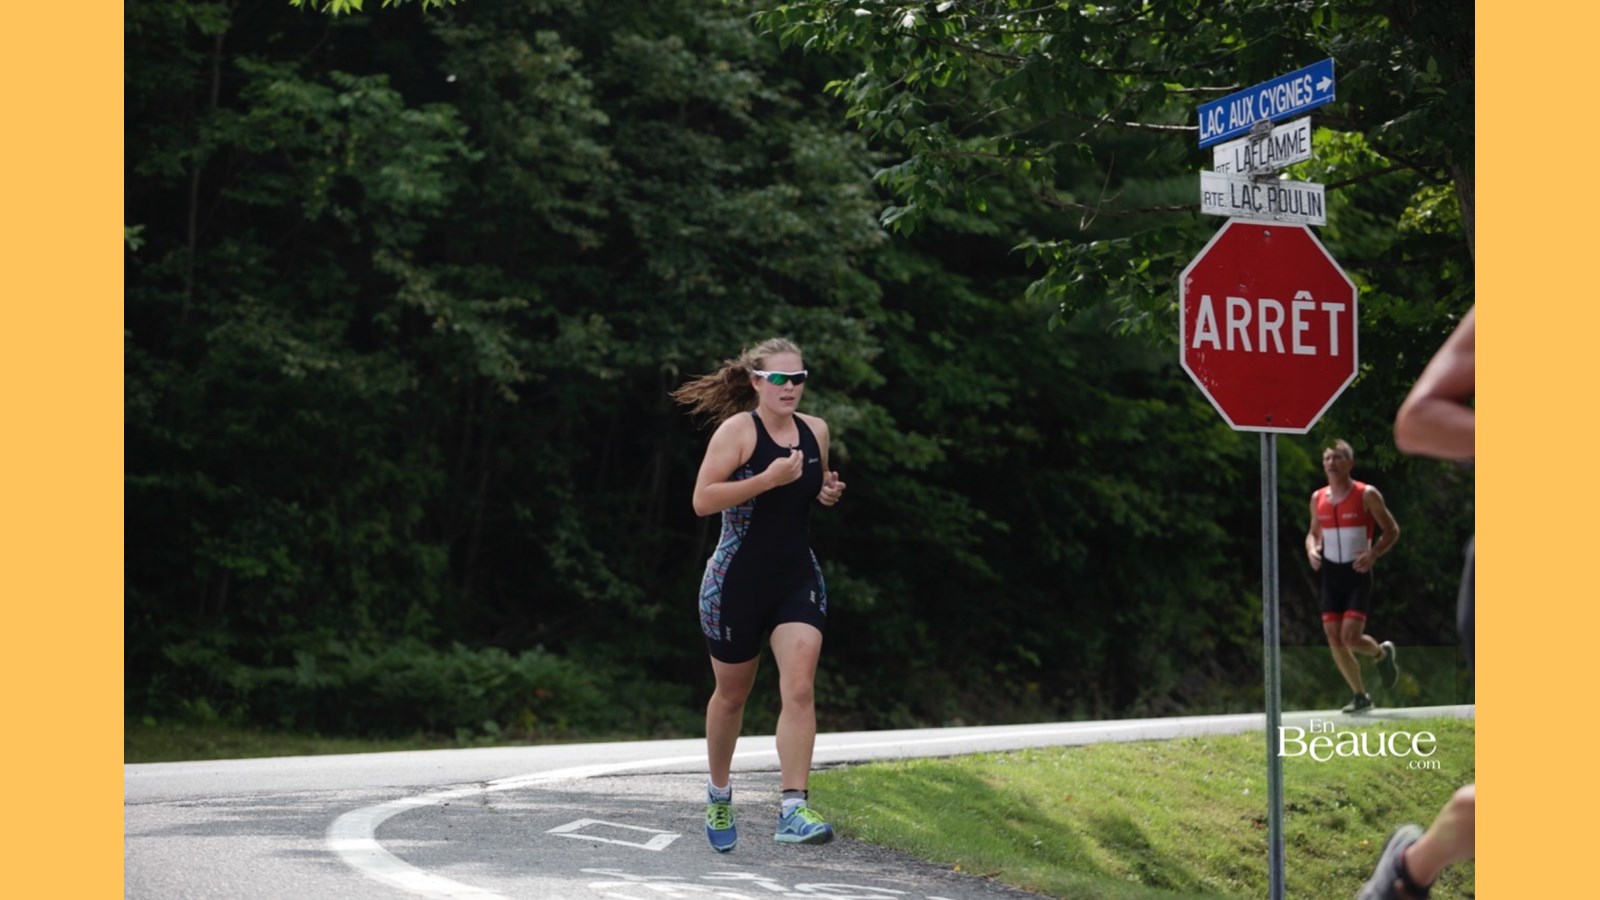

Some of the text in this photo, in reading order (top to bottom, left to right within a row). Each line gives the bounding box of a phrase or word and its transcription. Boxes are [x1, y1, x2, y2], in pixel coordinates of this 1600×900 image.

[1199, 74, 1313, 140] LAC AUX CYGNES
[1235, 126, 1307, 173] LAFLAMME
[1231, 183, 1262, 211] LAC
[1267, 187, 1323, 217] POULIN
[1192, 290, 1346, 356] ARRÊT
